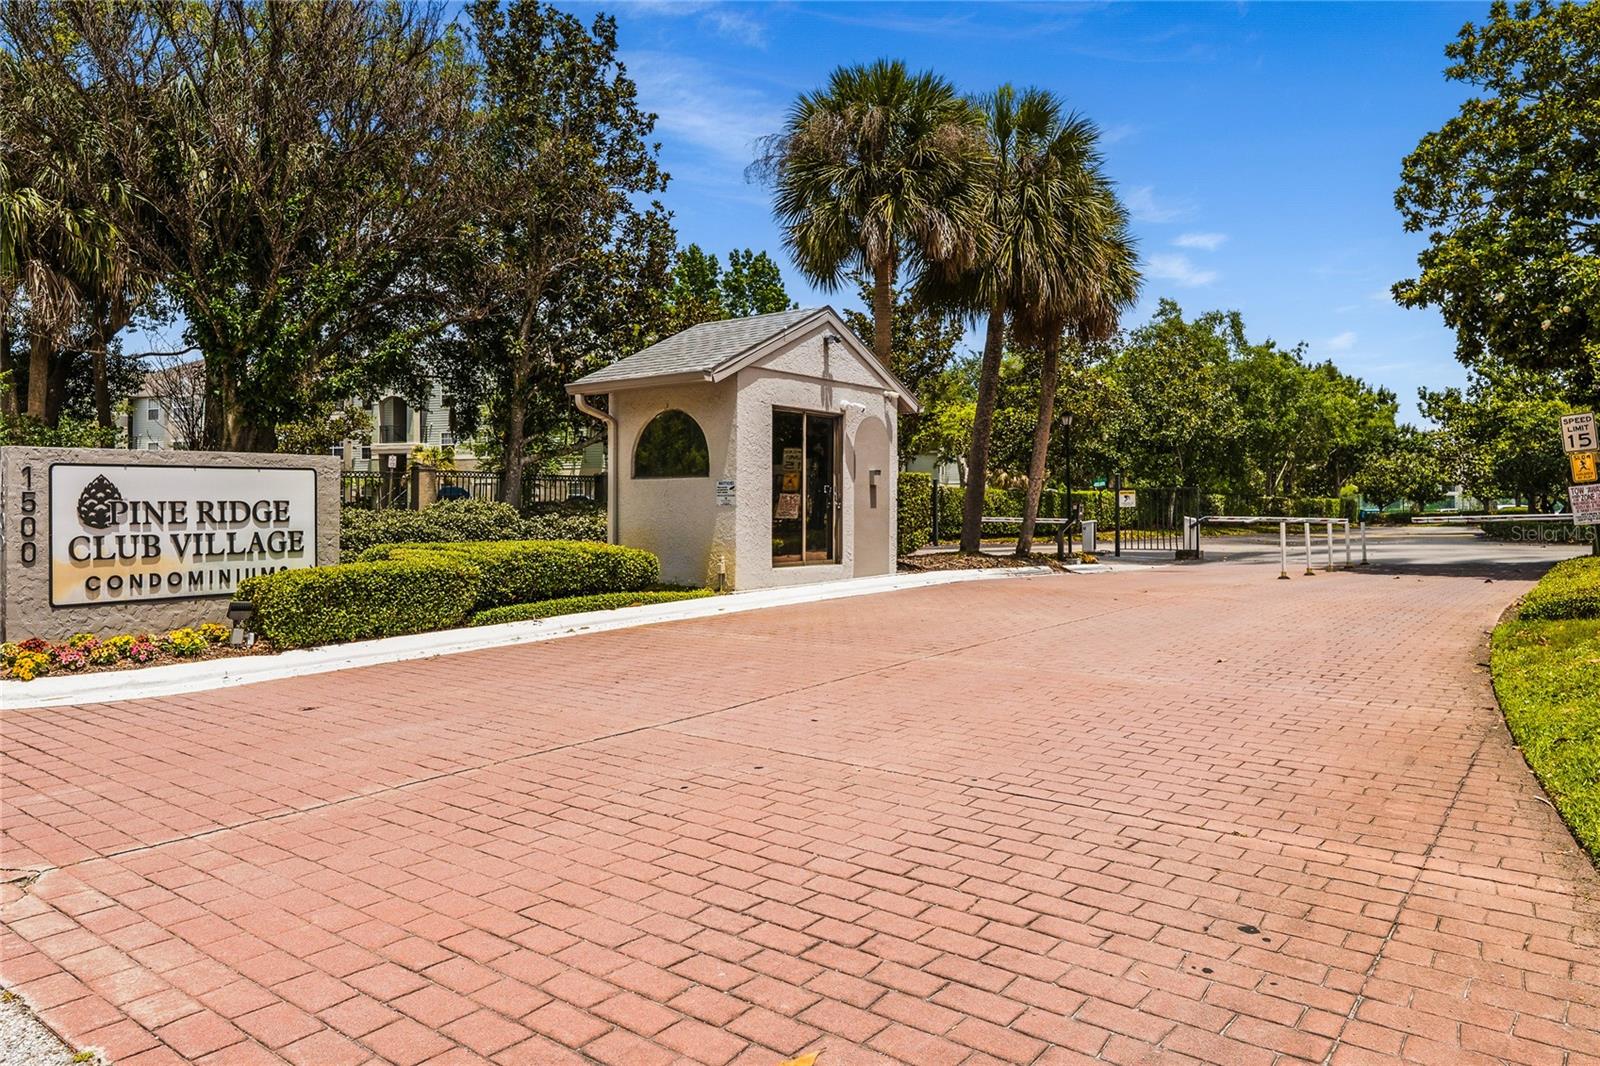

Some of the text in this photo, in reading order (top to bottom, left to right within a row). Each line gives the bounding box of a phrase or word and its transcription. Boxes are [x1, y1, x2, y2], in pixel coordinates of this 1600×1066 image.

[1563, 416, 1592, 425] SPEED
[1567, 433, 1592, 448] 15
[21, 466, 36, 563] 1500
[109, 500, 290, 525] PINE RIDGE
[68, 531, 305, 561] CLUB VILLAGE
